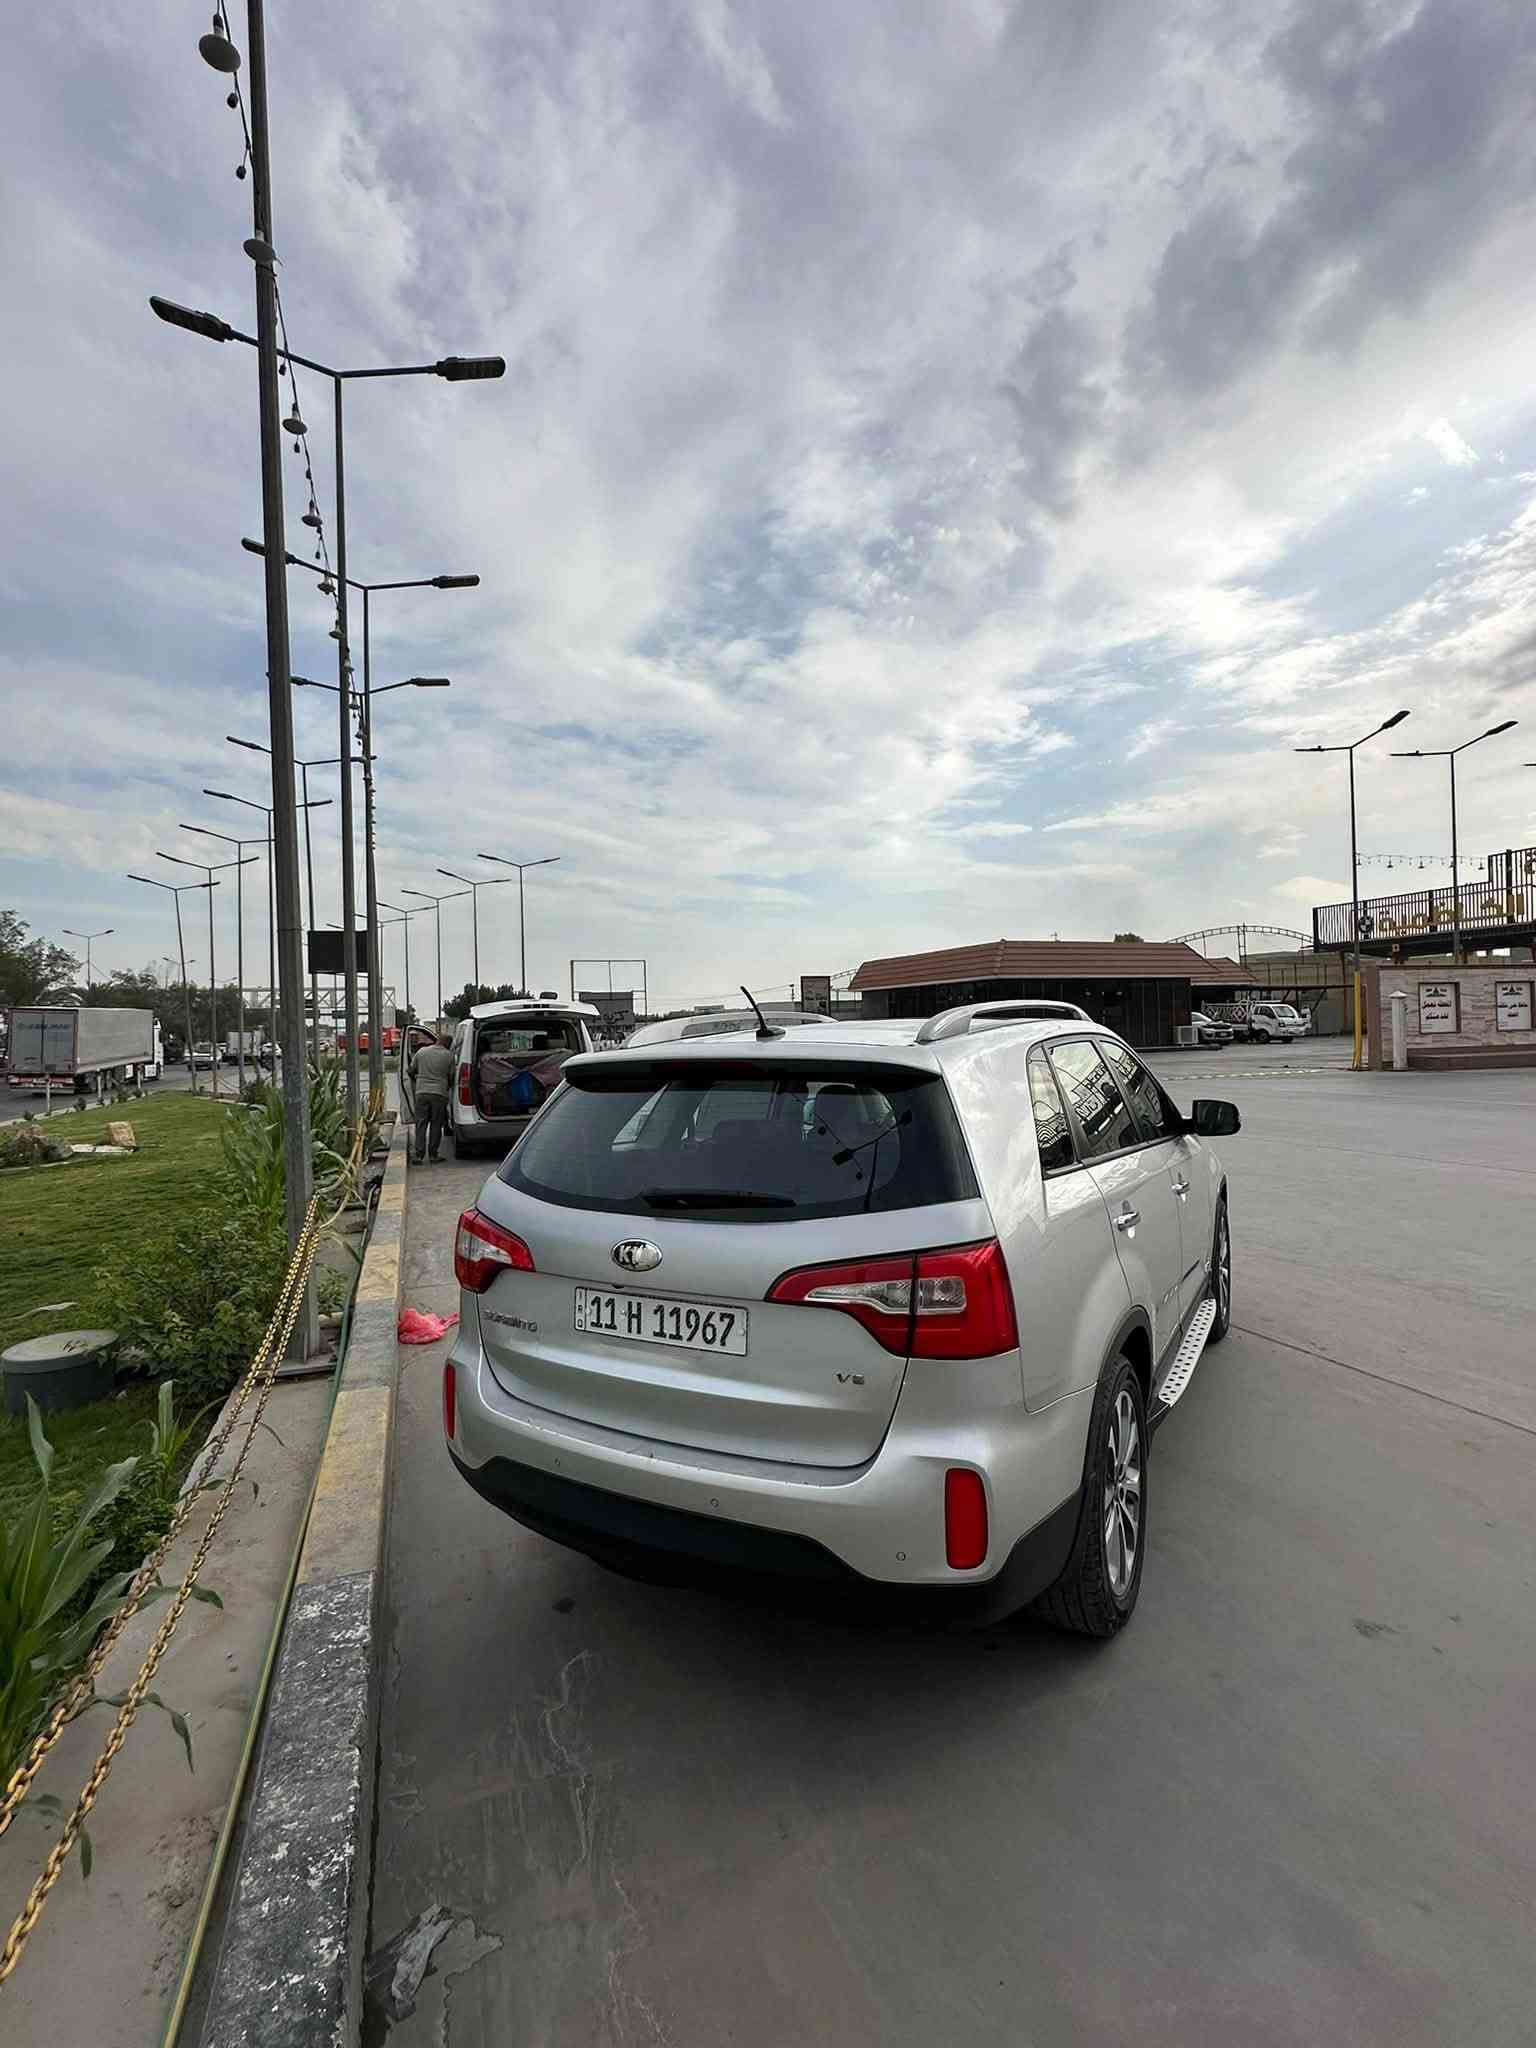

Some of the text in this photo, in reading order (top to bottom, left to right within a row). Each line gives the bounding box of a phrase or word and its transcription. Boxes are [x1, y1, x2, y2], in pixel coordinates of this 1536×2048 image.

[590, 1296, 735, 1346] 11 H 11967
